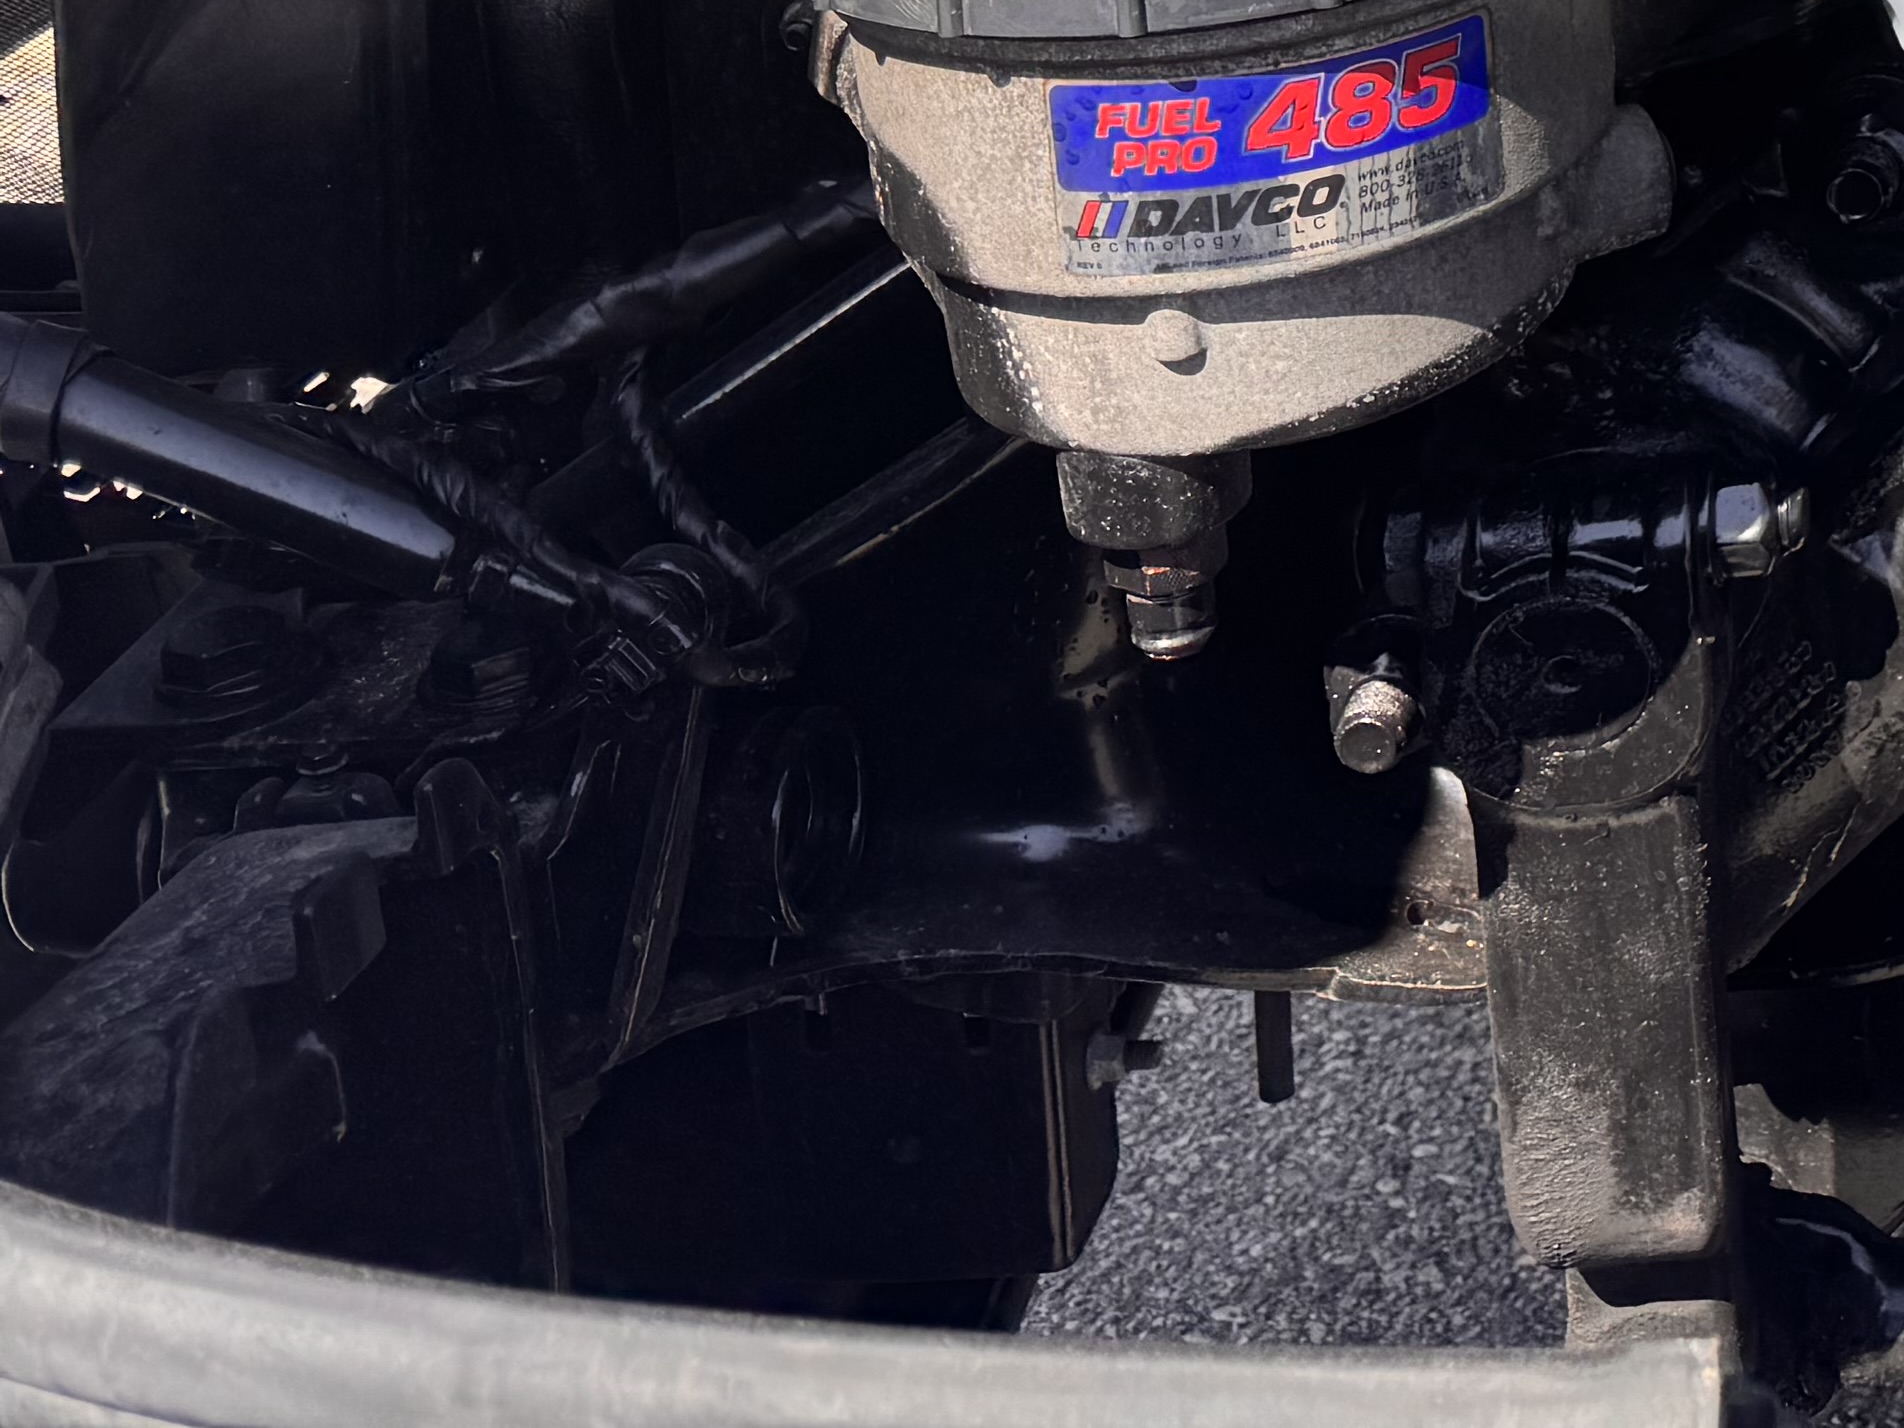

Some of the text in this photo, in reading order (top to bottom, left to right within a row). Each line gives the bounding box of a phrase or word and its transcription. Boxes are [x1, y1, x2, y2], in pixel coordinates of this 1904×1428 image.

[1095, 97, 1221, 139] FUEL
[1242, 33, 1461, 164] 485
[1111, 137, 1218, 178] PRO
[1129, 174, 1345, 238] DAVCO
[1360, 196, 1400, 213] Made
[1276, 216, 1326, 238] LLC
